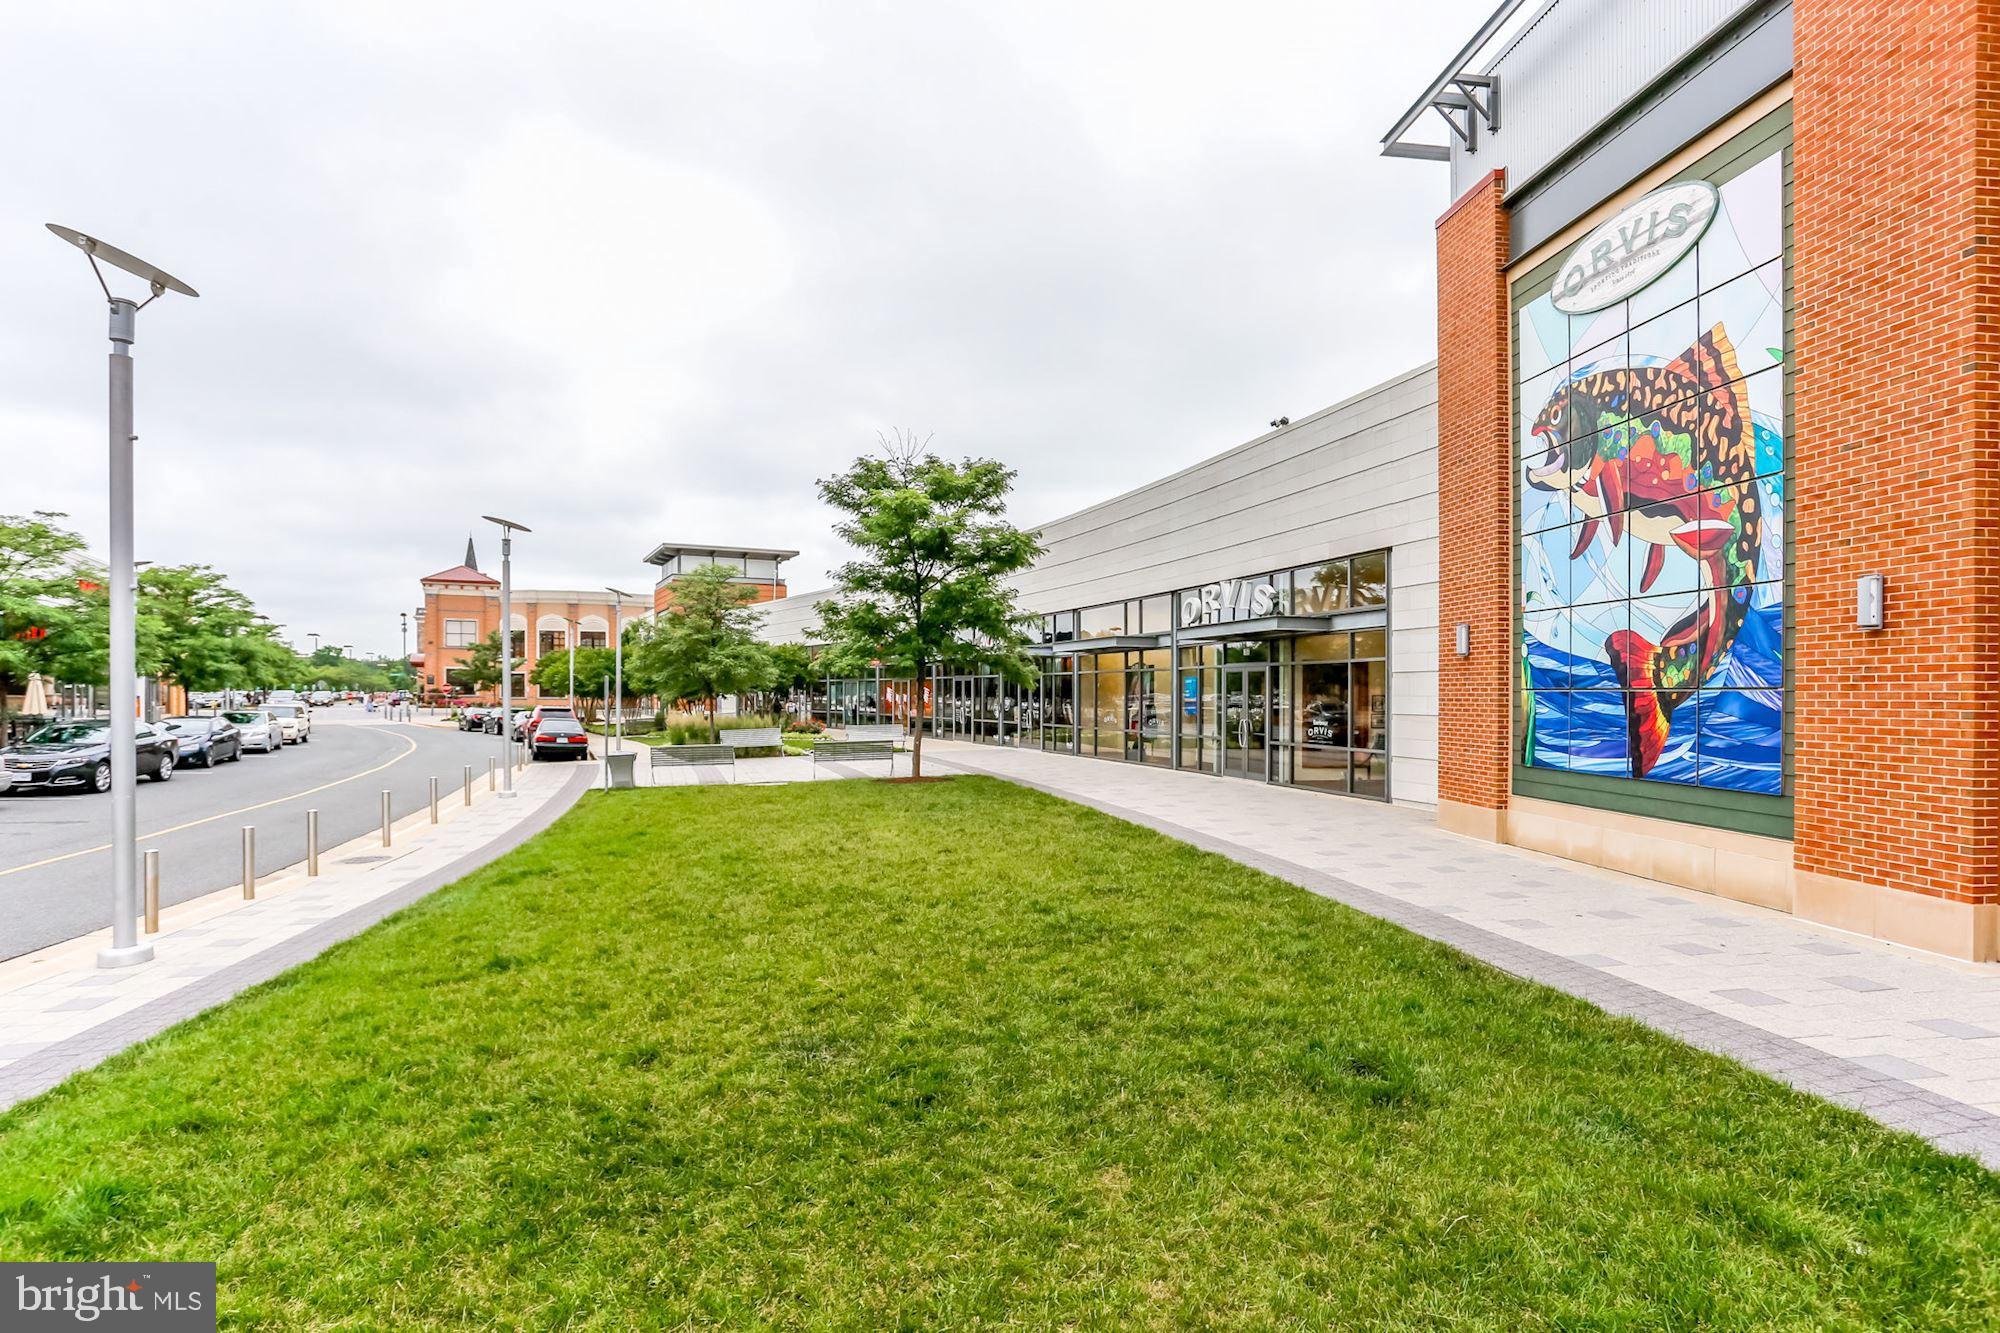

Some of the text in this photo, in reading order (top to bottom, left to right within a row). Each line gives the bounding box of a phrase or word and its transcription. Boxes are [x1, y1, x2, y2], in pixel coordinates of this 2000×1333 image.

[1564, 203, 1692, 297] ORVIS
[1181, 580, 1278, 626] ORVIS
[1308, 726, 1334, 738] ORVIS
